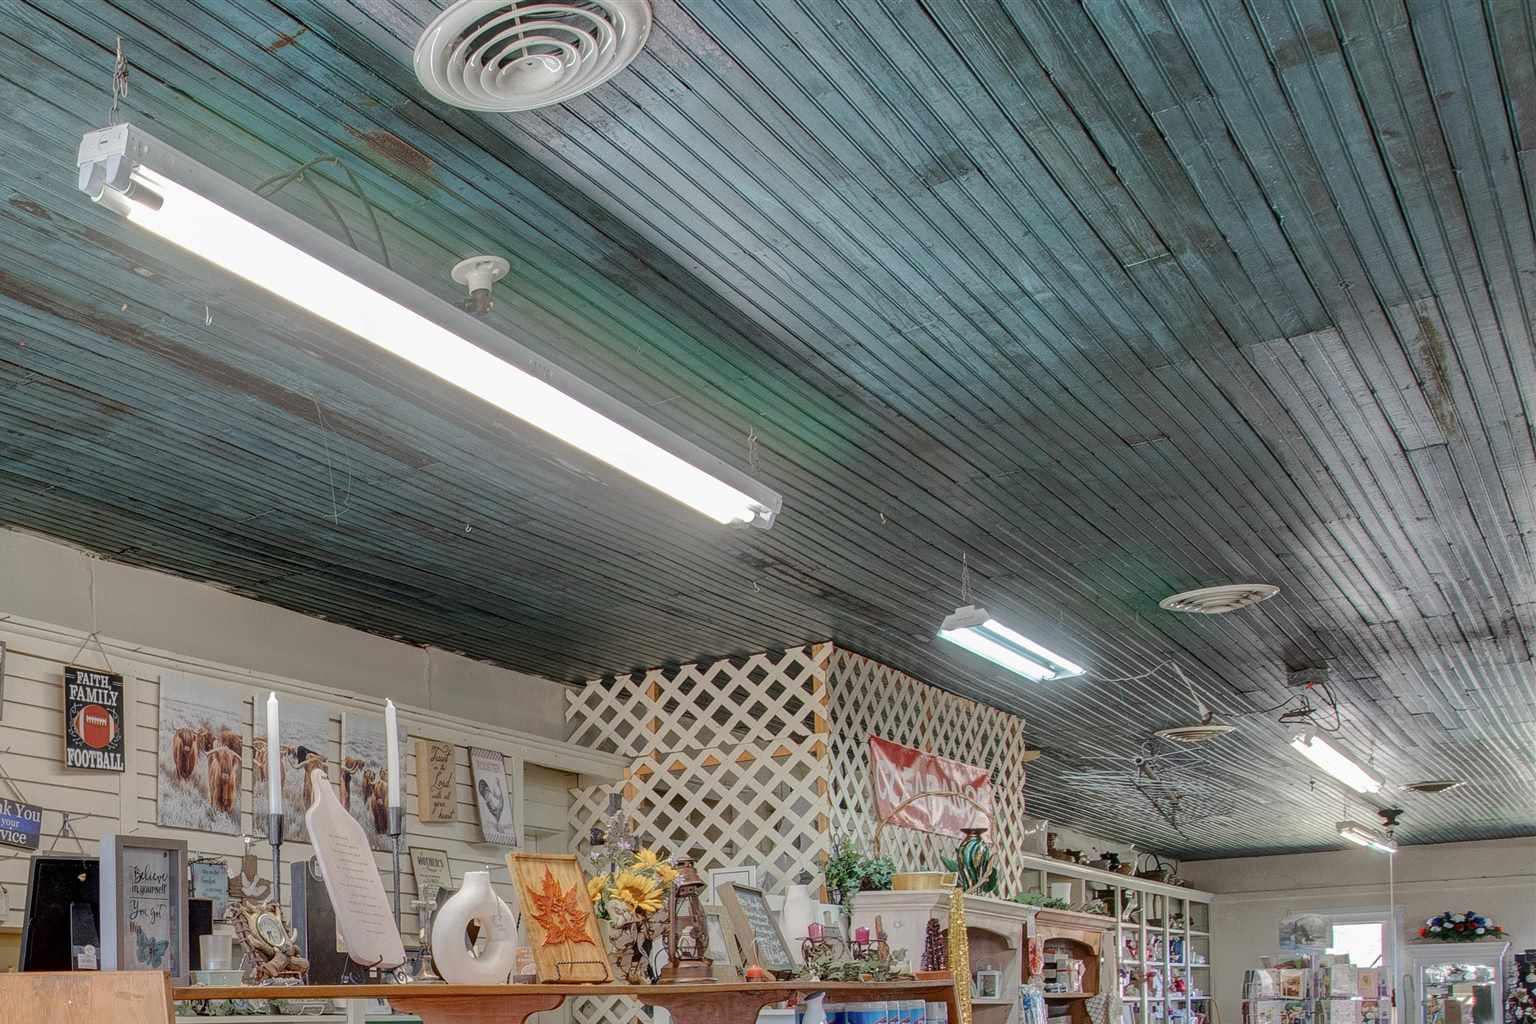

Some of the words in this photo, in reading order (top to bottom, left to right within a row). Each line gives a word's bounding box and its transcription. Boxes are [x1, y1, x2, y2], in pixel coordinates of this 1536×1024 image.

[76, 671, 112, 690] FAITH,
[68, 684, 119, 706] FAMILY
[66, 747, 124, 770] FOOTBALL
[15, 803, 41, 823] You
[0, 817, 20, 830] your
